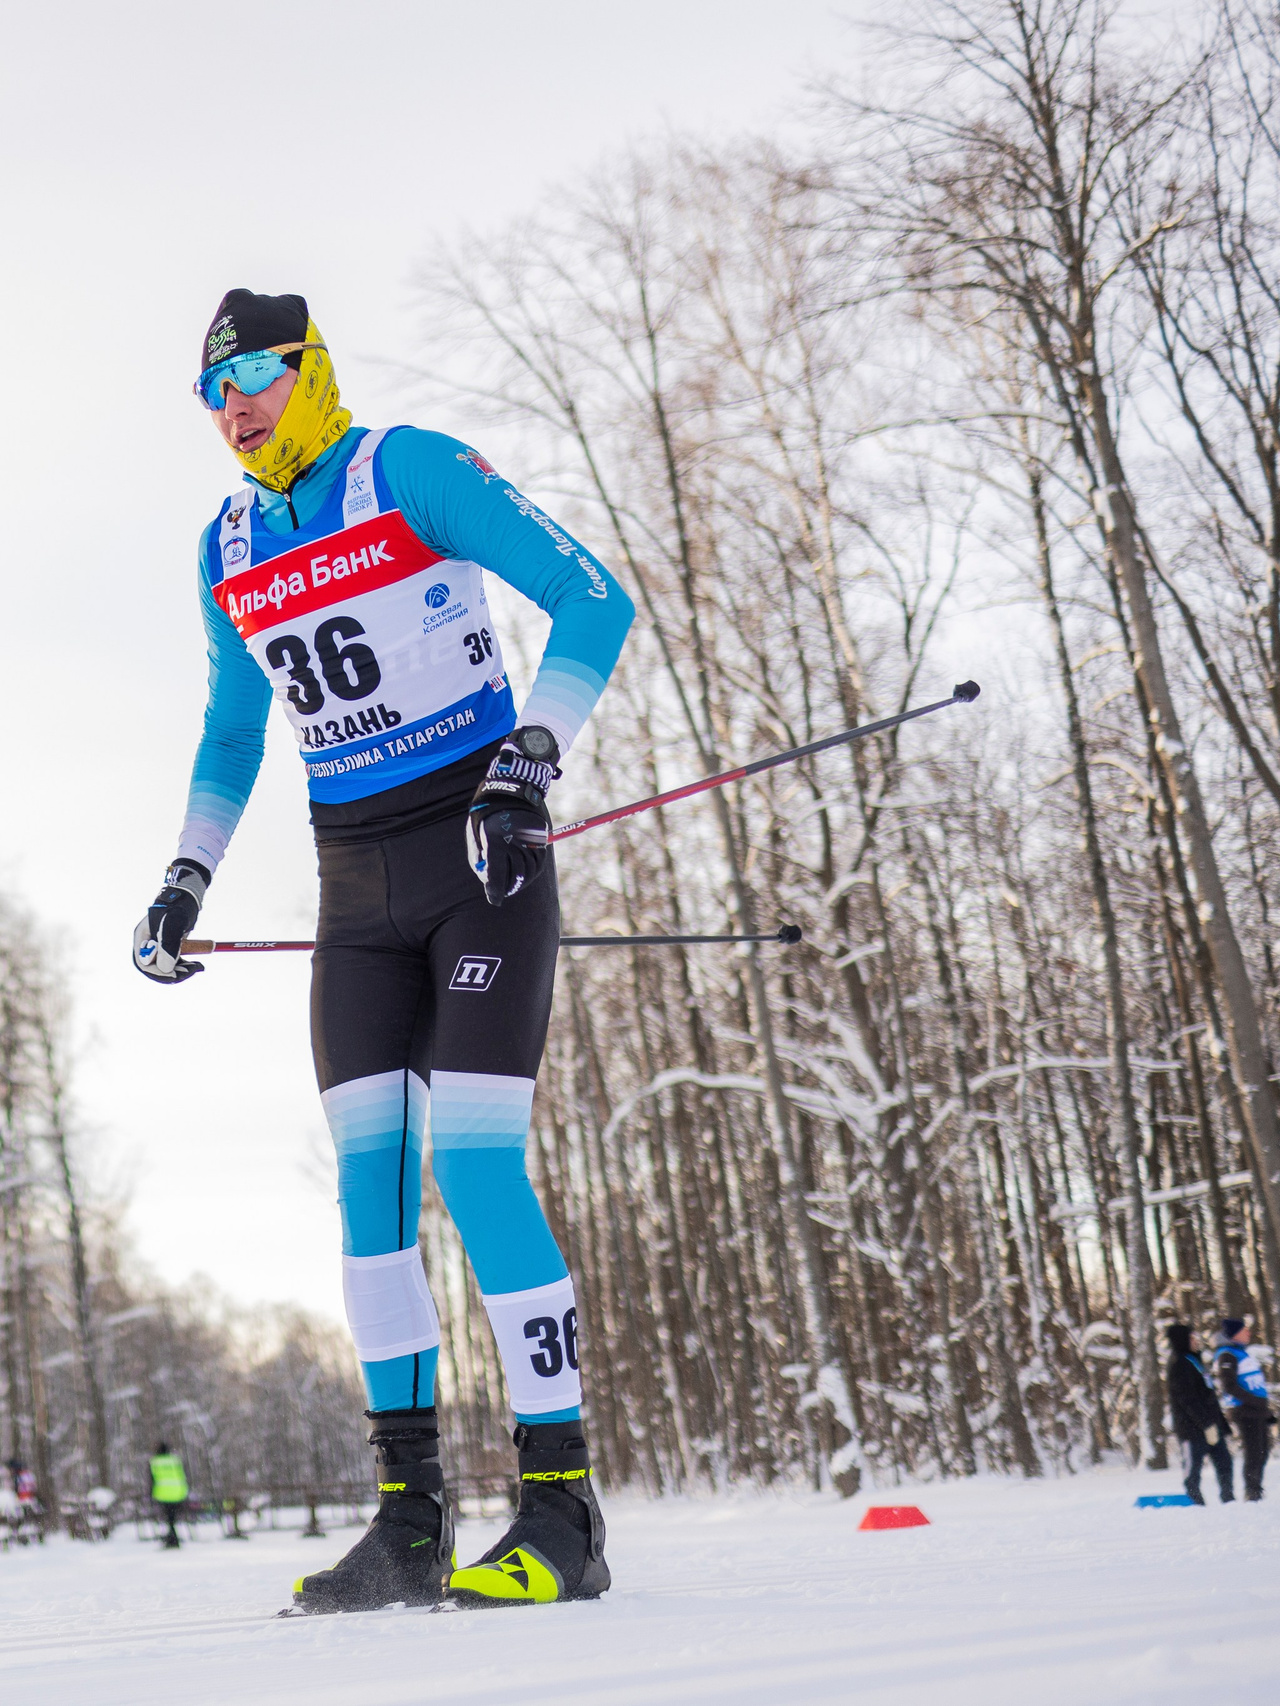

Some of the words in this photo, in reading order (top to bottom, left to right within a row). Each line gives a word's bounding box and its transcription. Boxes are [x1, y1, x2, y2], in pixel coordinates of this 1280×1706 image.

[227, 570, 306, 622] Альфа
[310, 539, 396, 588] Банк
[423, 601, 462, 626] Сетевая
[423, 608, 469, 635] Компания
[266, 616, 381, 715] 36
[384, 708, 477, 758] ТАТАРСТАН
[521, 1468, 586, 1482] FISCHER
